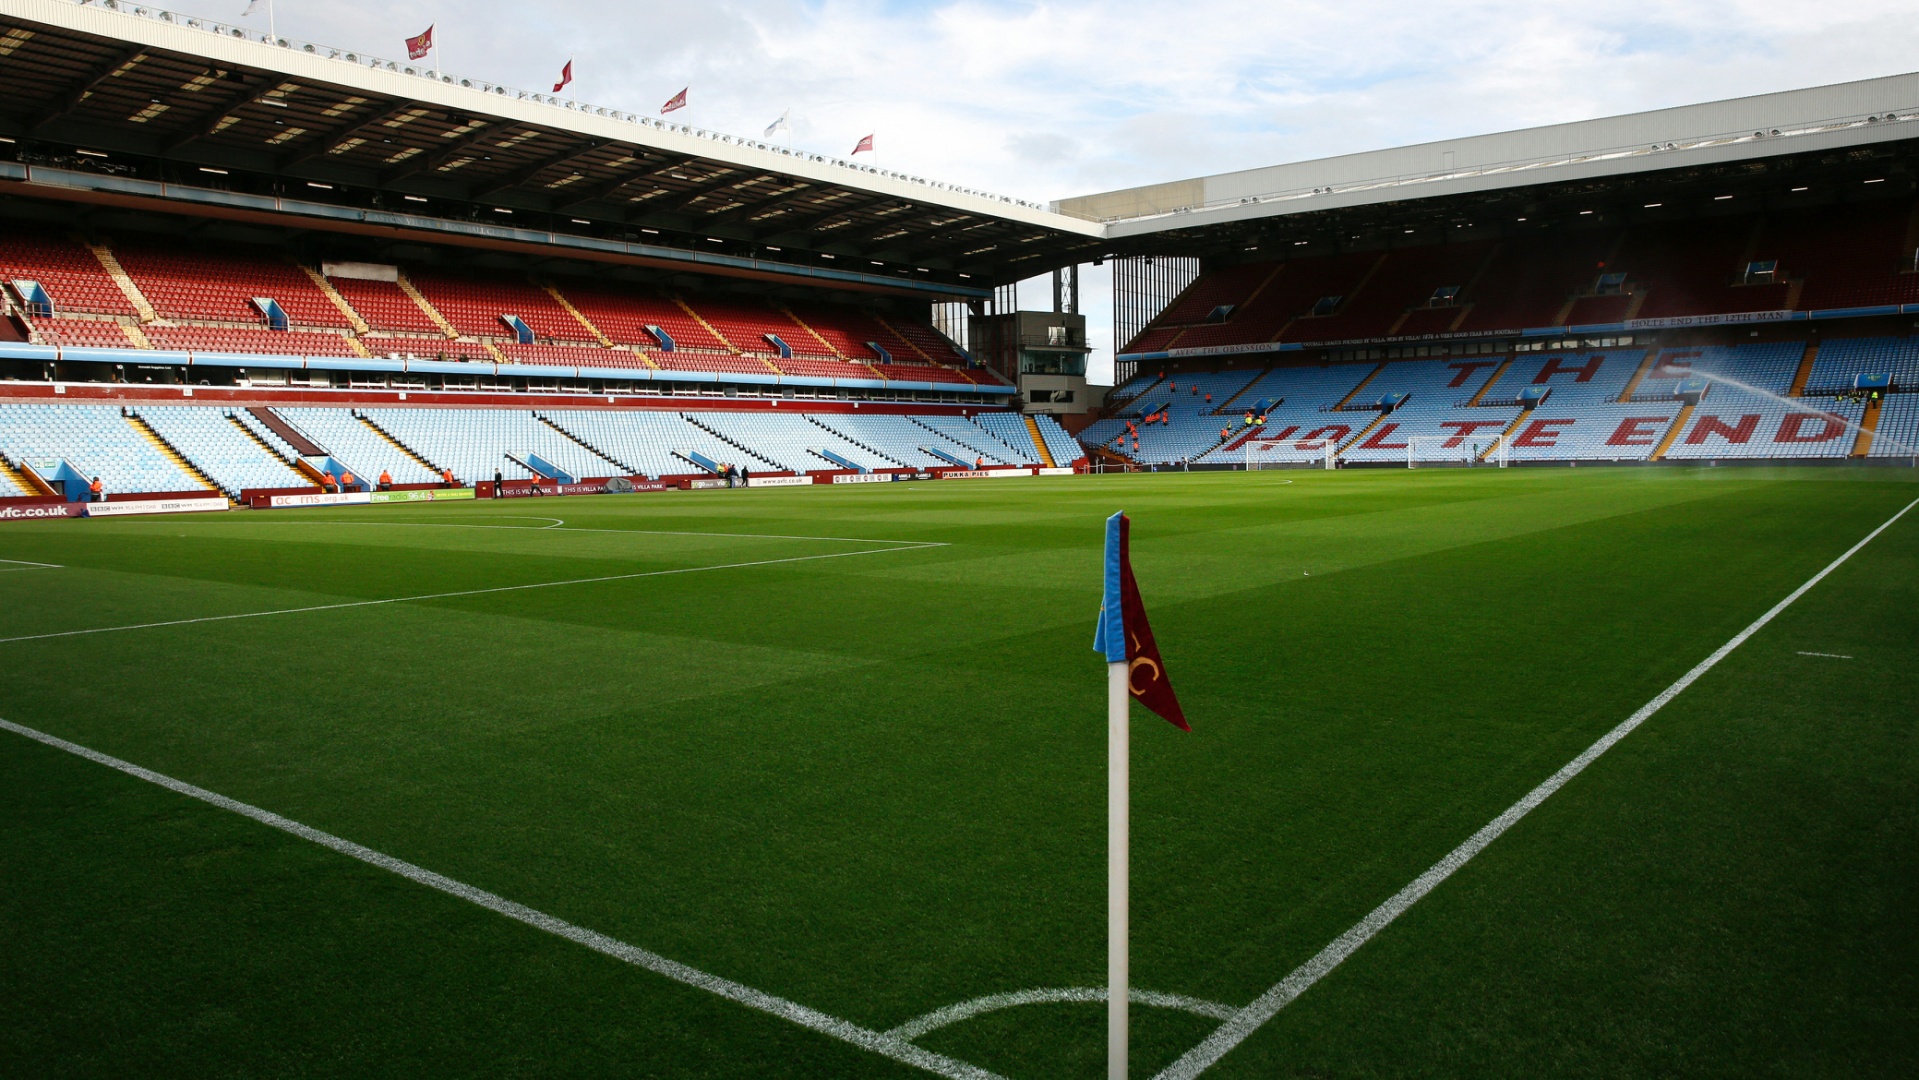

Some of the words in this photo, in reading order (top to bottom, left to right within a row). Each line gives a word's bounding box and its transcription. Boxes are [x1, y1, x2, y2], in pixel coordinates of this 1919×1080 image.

[374, 214, 402, 224] ASTON
[405, 217, 432, 228] VILLA
[444, 222, 486, 234] FOOTBALL
[1631, 319, 1664, 328] HOLTE
[1697, 316, 1720, 324] THE
[1757, 312, 1784, 320] MAN
[1175, 348, 1196, 356] AVFC
[1222, 344, 1272, 353] OBSESSION
[1447, 351, 1702, 388] THE
[1222, 419, 1576, 451] HOLTE
[1605, 412, 1850, 446] END
[275, 494, 349, 505] acrns.org.uk
